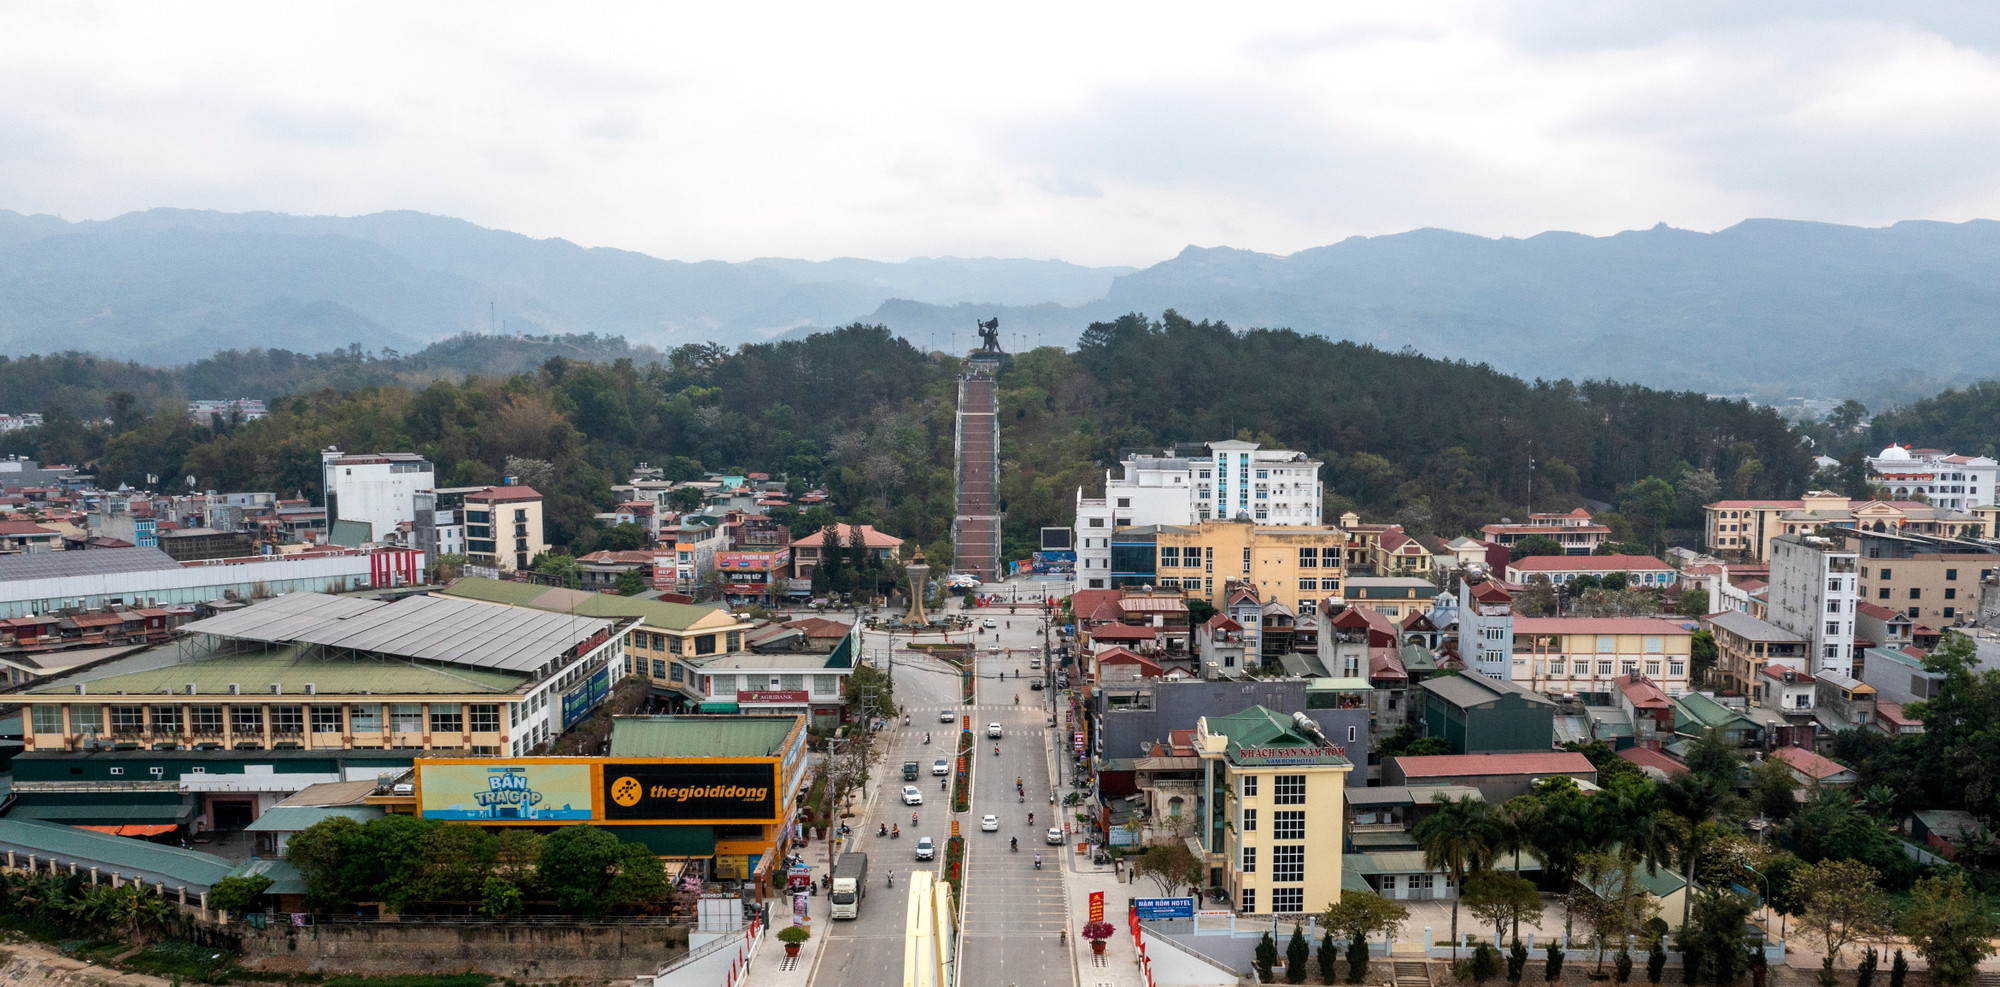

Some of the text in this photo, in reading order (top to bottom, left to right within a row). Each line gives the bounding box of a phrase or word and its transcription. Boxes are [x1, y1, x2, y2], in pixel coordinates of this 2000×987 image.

[1240, 746, 1275, 758] KHÁCH
[489, 773, 527, 791] BÁN
[508, 787, 542, 806] GÓP
[650, 785, 768, 802] thegioididong
